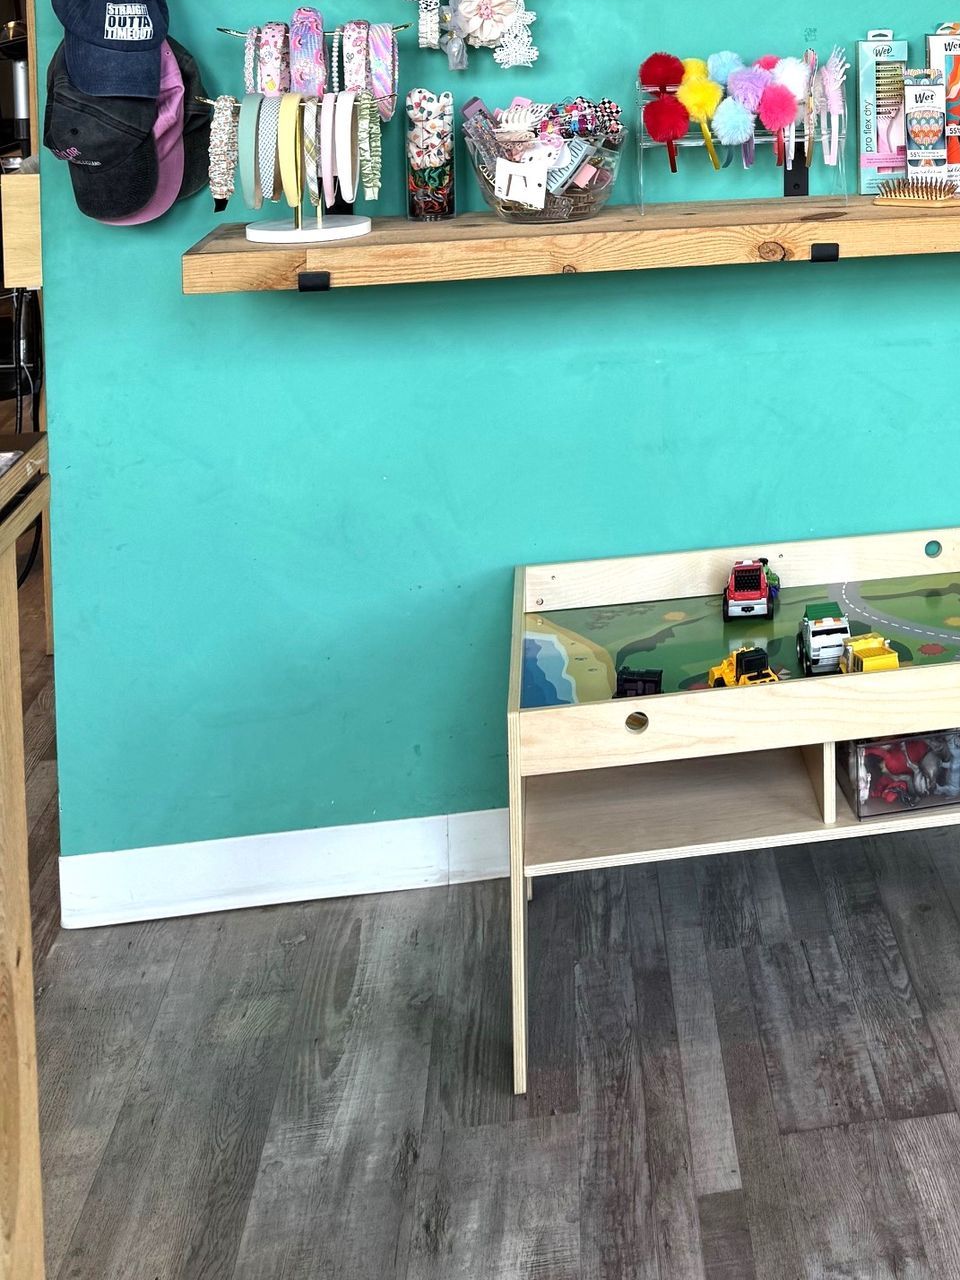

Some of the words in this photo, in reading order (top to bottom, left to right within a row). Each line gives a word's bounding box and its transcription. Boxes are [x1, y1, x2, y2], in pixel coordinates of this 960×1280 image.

[108, 15, 150, 28] OUTTA
[875, 46, 891, 57] Wet
[914, 92, 935, 104] Wet
[863, 100, 873, 117] dry
[863, 118, 872, 136] flex
[949, 127, 960, 135] 55%
[865, 139, 874, 153] pro
